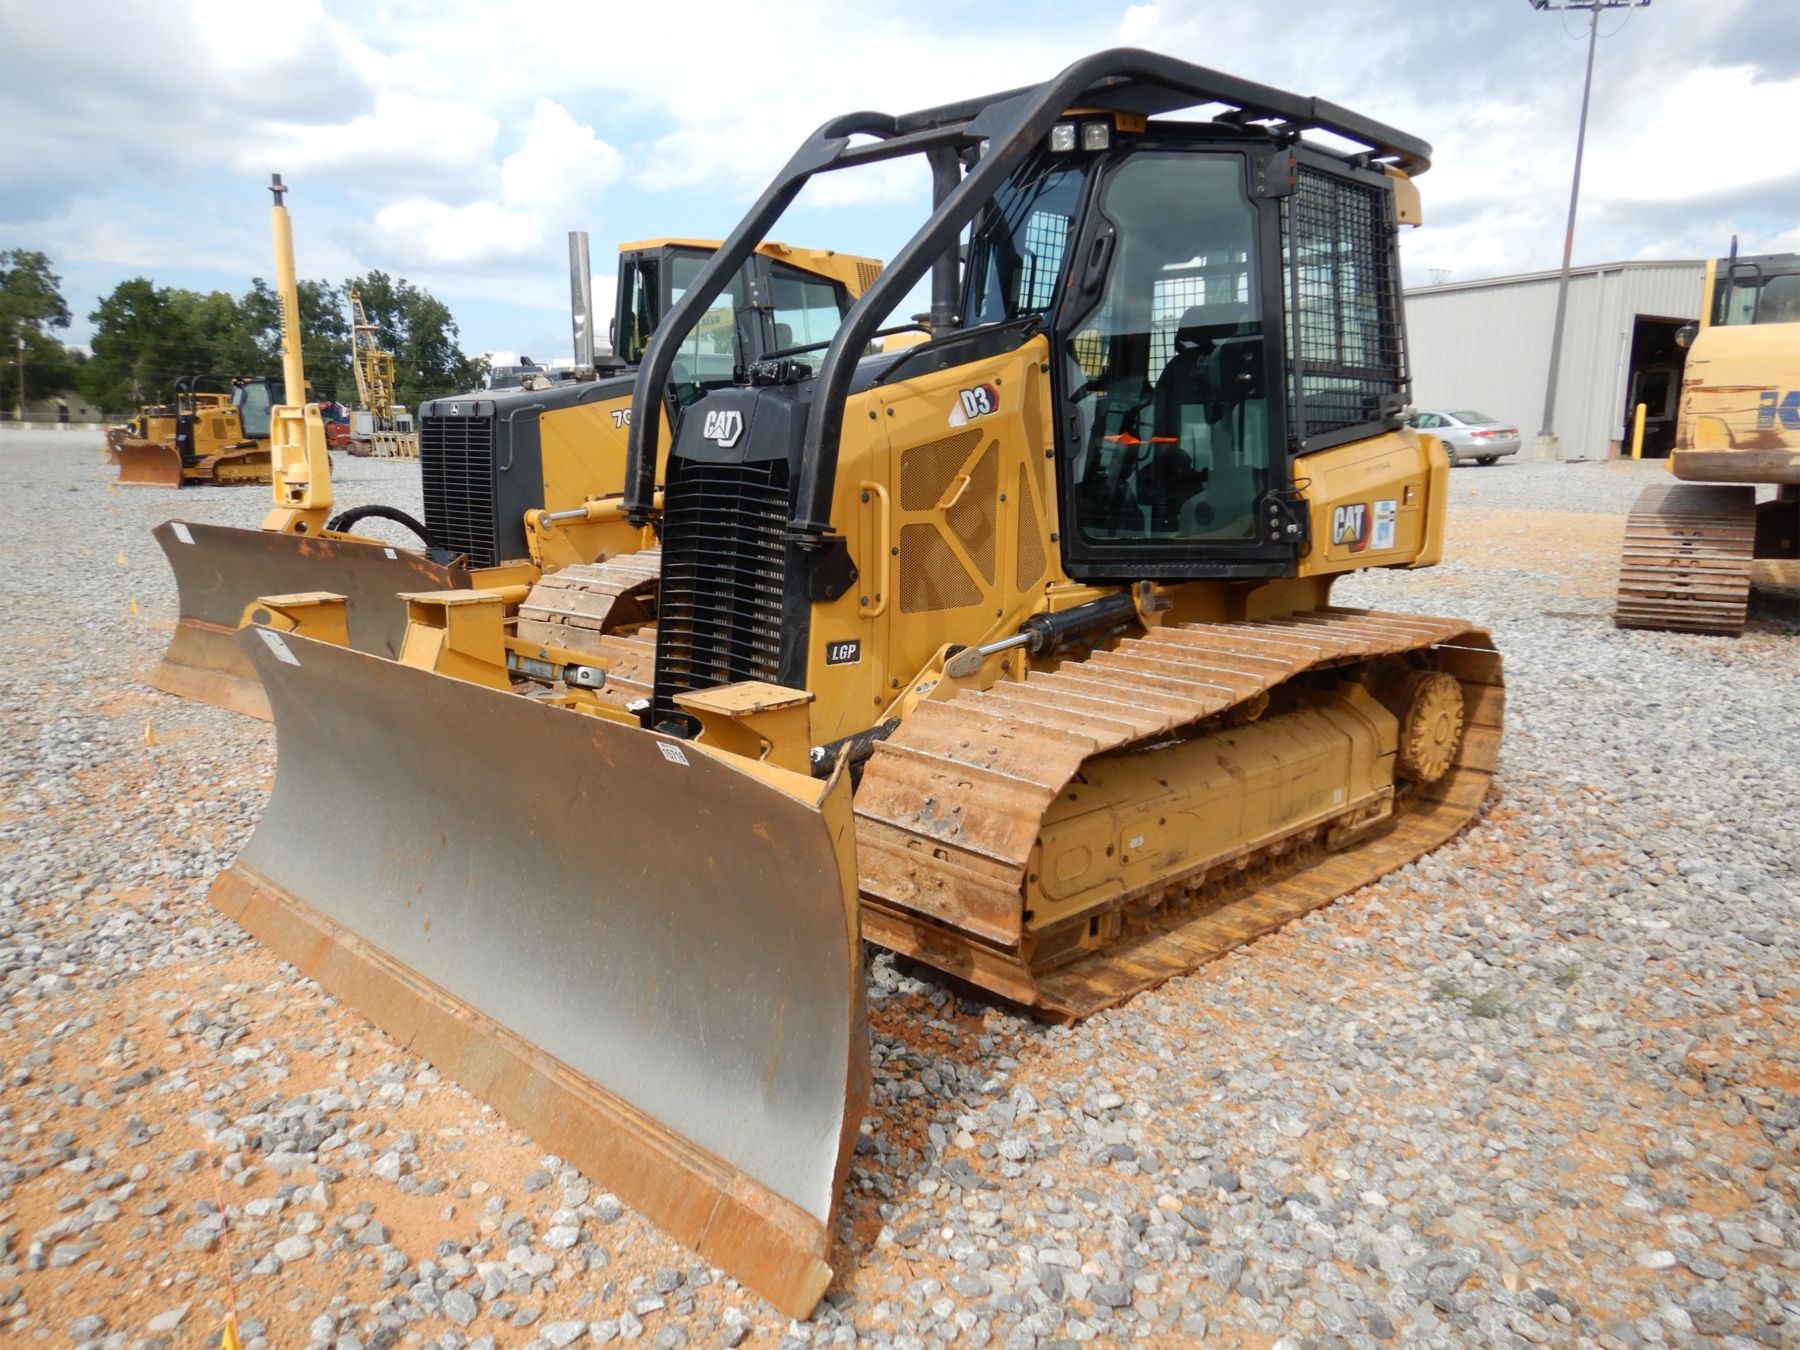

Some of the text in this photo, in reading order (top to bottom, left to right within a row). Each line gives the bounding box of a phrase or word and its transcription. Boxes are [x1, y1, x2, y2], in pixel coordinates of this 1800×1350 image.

[960, 386, 991, 418] D3
[704, 411, 738, 440] CAT
[1333, 504, 1366, 545] CAT
[832, 644, 857, 660] LGP
